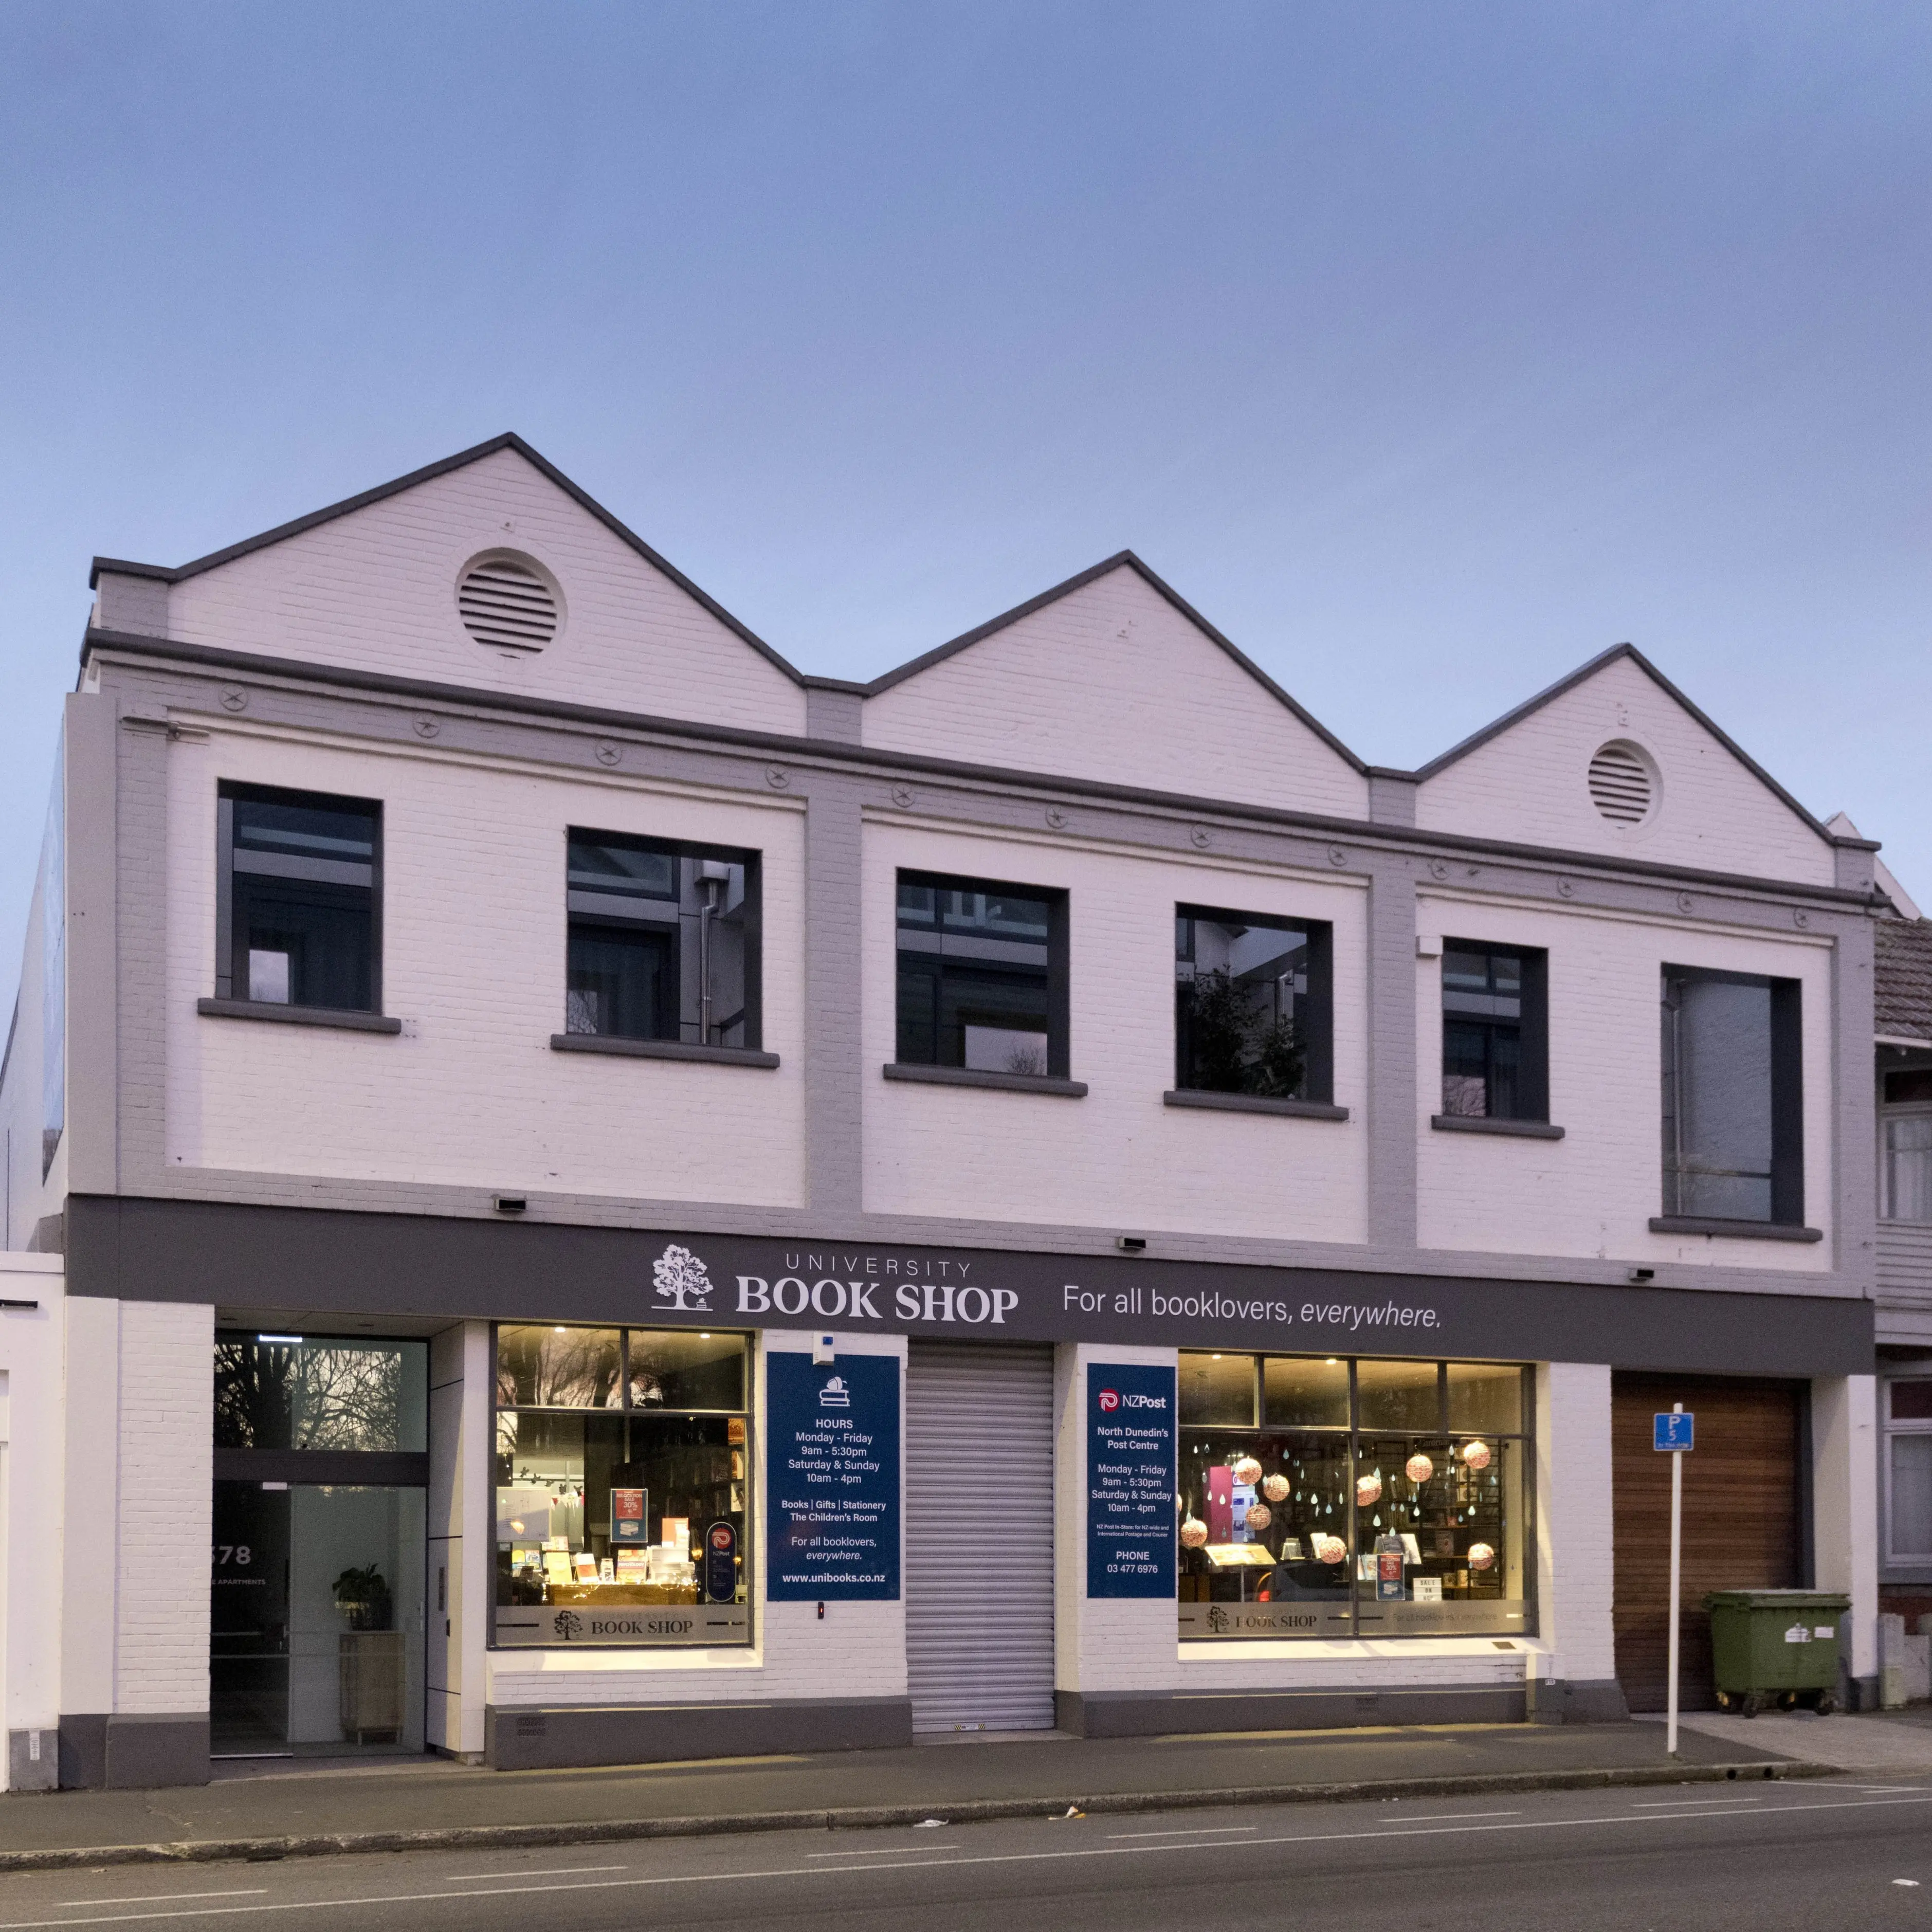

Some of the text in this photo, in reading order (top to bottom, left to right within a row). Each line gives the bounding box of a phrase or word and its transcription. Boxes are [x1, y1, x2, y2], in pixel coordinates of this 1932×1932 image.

[786, 1253, 970, 1278] UNIVERSITY
[735, 1276, 1018, 1324] BOOK SHOP
[1065, 1285, 1441, 1331] For all booklovers, everywhere.
[816, 1419, 853, 1429] HOURS
[1669, 1416, 1681, 1429] P
[1098, 1427, 1169, 1437] North Dunedin’s
[1669, 1430, 1676, 1441] 5
[796, 1432, 834, 1444] Monday
[843, 1433, 872, 1445] Friday
[1107, 1440, 1159, 1450] Post Centre
[801, 1446, 823, 1455] 9am
[832, 1447, 867, 1457] 5:30pm
[789, 1459, 880, 1472] Saturday & Sunday
[1098, 1464, 1133, 1475] Monday
[1140, 1465, 1167, 1475] Friday
[806, 1473, 831, 1483] 10am
[841, 1474, 862, 1485] 4pm
[1102, 1478, 1121, 1486] 9am
[1129, 1478, 1162, 1488] 5:30pm
[1091, 1490, 1172, 1502] Saturday & Sunday
[781, 1500, 809, 1509] Books
[816, 1500, 836, 1509] Gifts
[843, 1501, 886, 1511] Stationery
[1107, 1503, 1129, 1511] 10am
[1137, 1504, 1156, 1513] 4pm
[790, 1512, 878, 1522] The Children’s Room
[792, 1536, 877, 1547] For all booklovers,
[211, 1546, 251, 1564] 78
[806, 1551, 862, 1561] everywhere.
[1116, 1551, 1150, 1560] PHONE
[1107, 1564, 1158, 1573] 03 477 6976
[782, 1573, 885, 1583] www.unibooks.co.nz
[1281, 1615, 1317, 1627] SHOP
[591, 1620, 693, 1634] BOOK SHOP
